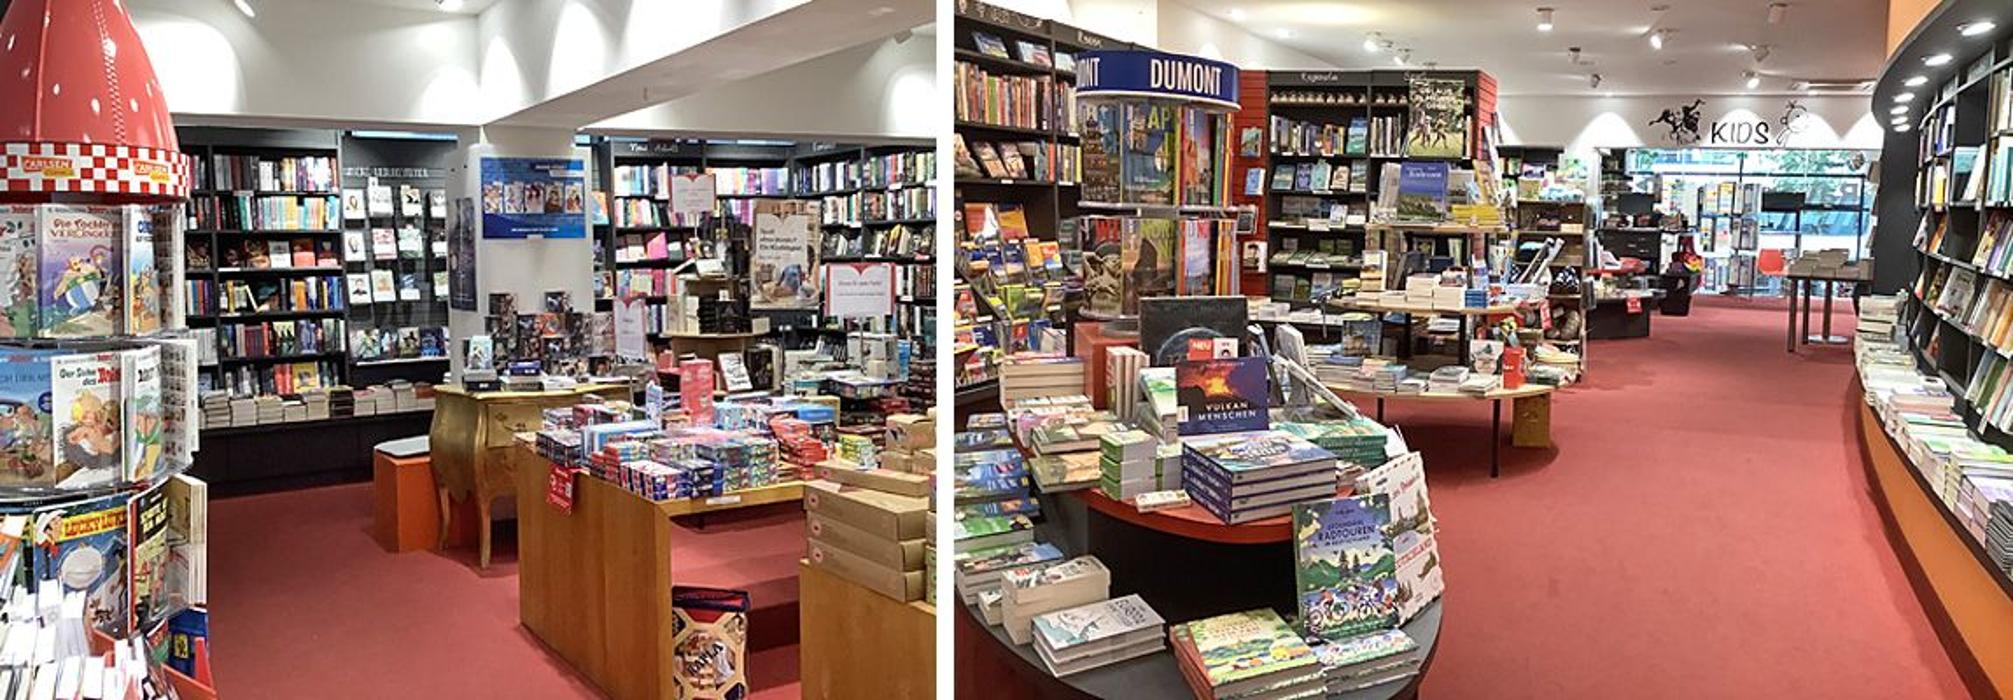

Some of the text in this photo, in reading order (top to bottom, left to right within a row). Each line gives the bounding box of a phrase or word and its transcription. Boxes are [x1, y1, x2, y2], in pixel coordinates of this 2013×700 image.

[1151, 59, 1222, 96] DUMONT
[1711, 121, 1769, 144] KIDS
[24, 158, 72, 170] CARLSEN
[1193, 341, 1210, 350] NEU
[1205, 402, 1248, 412] VULKAN
[1198, 410, 1257, 421] MENSCHEN
[64, 510, 100, 537] LUCKY
[1318, 524, 1377, 541] RADTOUREN
